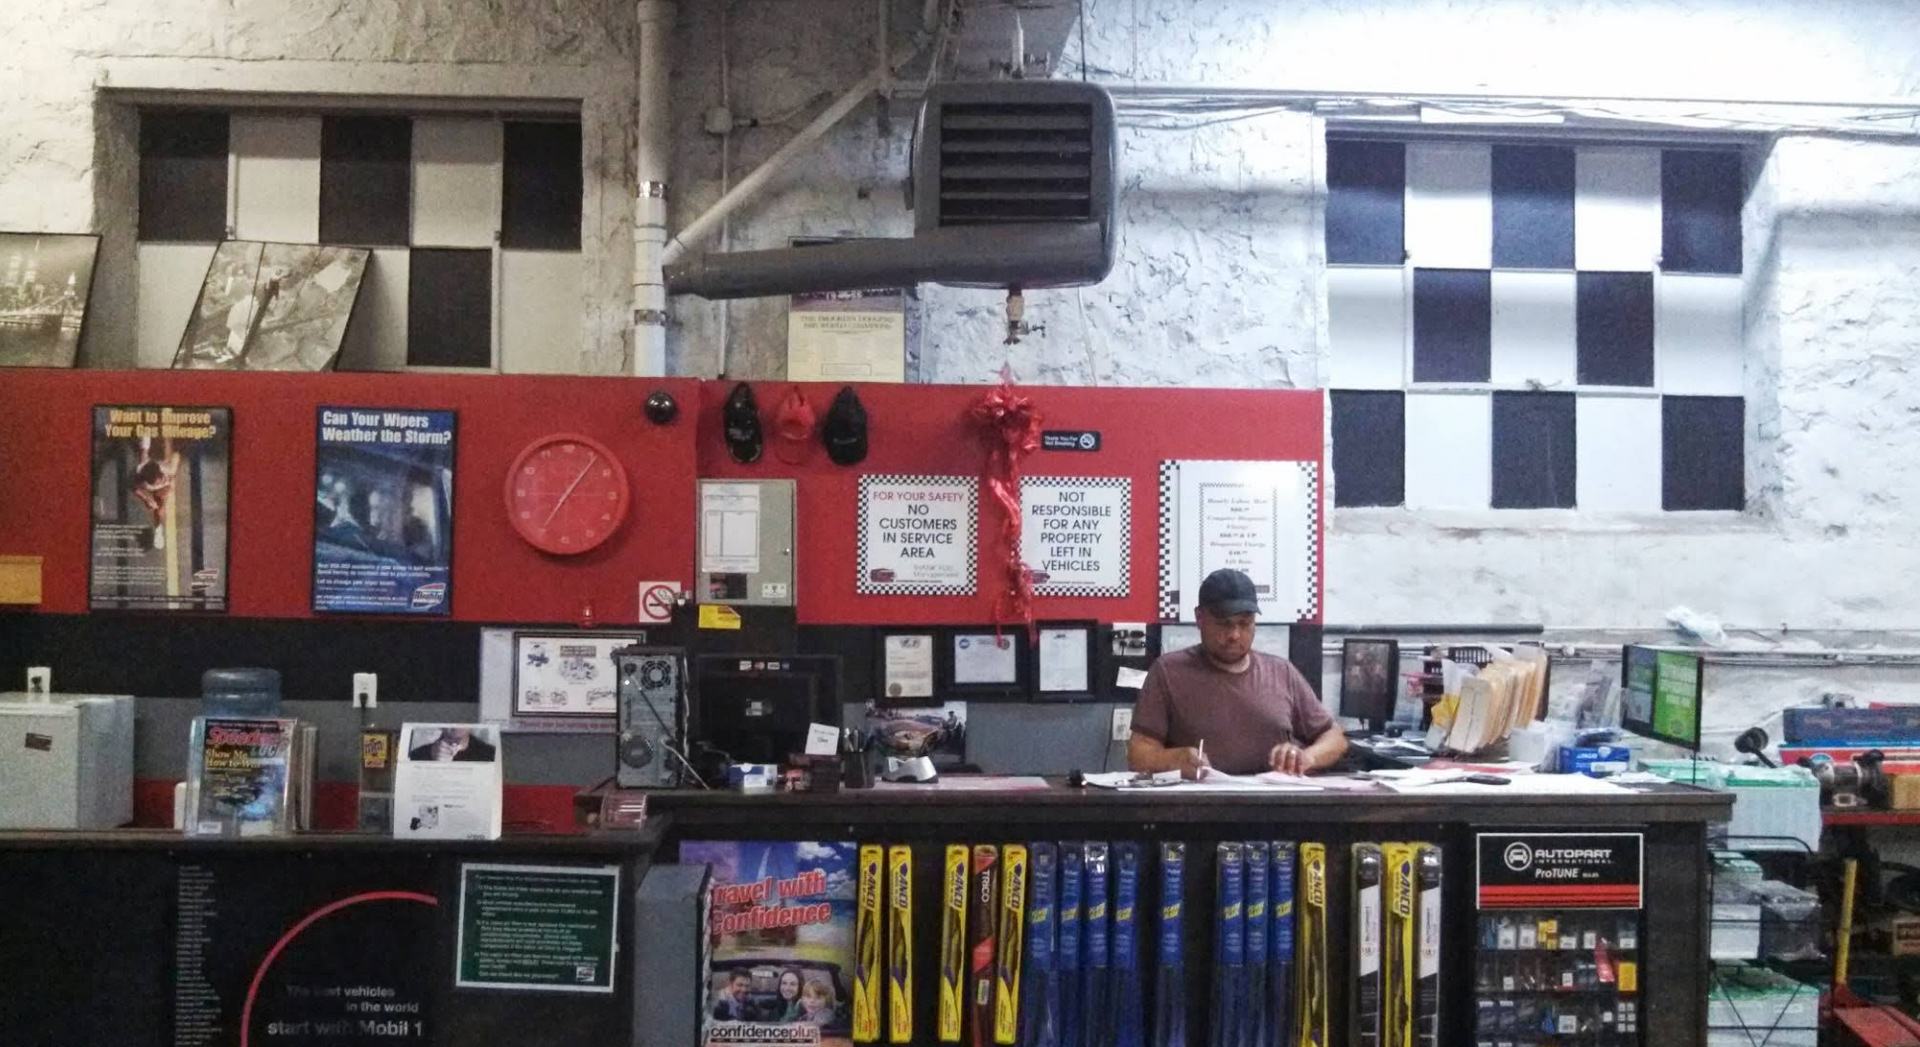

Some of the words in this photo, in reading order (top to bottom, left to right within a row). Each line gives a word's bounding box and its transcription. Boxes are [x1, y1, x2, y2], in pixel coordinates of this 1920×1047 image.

[109, 410, 142, 423] Want
[146, 411, 157, 424] to
[323, 411, 348, 425] Can
[351, 412, 380, 427] Your
[383, 413, 429, 428] Wipers
[105, 424, 133, 437] Your
[136, 424, 158, 438] Gas
[161, 425, 217, 439] Mileage?
[322, 427, 377, 442] Weather
[381, 429, 402, 443] the
[405, 430, 452, 445] Storm?
[873, 491, 894, 501] FOR
[897, 491, 926, 501] YOUR
[928, 492, 964, 502] SAFETY
[1059, 491, 1085, 503] NOT
[907, 504, 929, 515] NO
[1031, 505, 1111, 517] RESPONSIBLE
[879, 518, 957, 530] CUSTOMERS
[1043, 518, 1068, 530] FOR
[1072, 519, 1100, 530] ANY
[883, 532, 896, 543] IN
[900, 532, 953, 544] SERVICE
[1040, 532, 1102, 544] PROPERTY
[900, 547, 935, 558] AREA
[1050, 546, 1074, 557] LEFT
[1079, 547, 1092, 558] IN
[1042, 560, 1100, 572] VEHICLES
[205, 748, 230, 758] Show
[233, 750, 248, 759] Me
[1535, 849, 1612, 858] AUTOPART
[1535, 867, 1579, 879] ProTUNE
[776, 870, 827, 899] with
[981, 869, 990, 903] TRICO
[865, 875, 876, 909] ANCO
[898, 875, 908, 909] ANCO
[953, 875, 964, 909] ANCO
[1011, 875, 1022, 909] ANCO
[1400, 878, 1410, 916] ANCO
[344, 985, 396, 997] vehicles
[347, 1002, 357, 1012] in
[361, 1002, 381, 1012] the
[384, 1002, 419, 1013] world
[267, 1020, 311, 1035] start
[359, 1020, 409, 1036] Mobil
[414, 1021, 423, 1036] 1
[711, 1024, 818, 1039] confidenceplus
